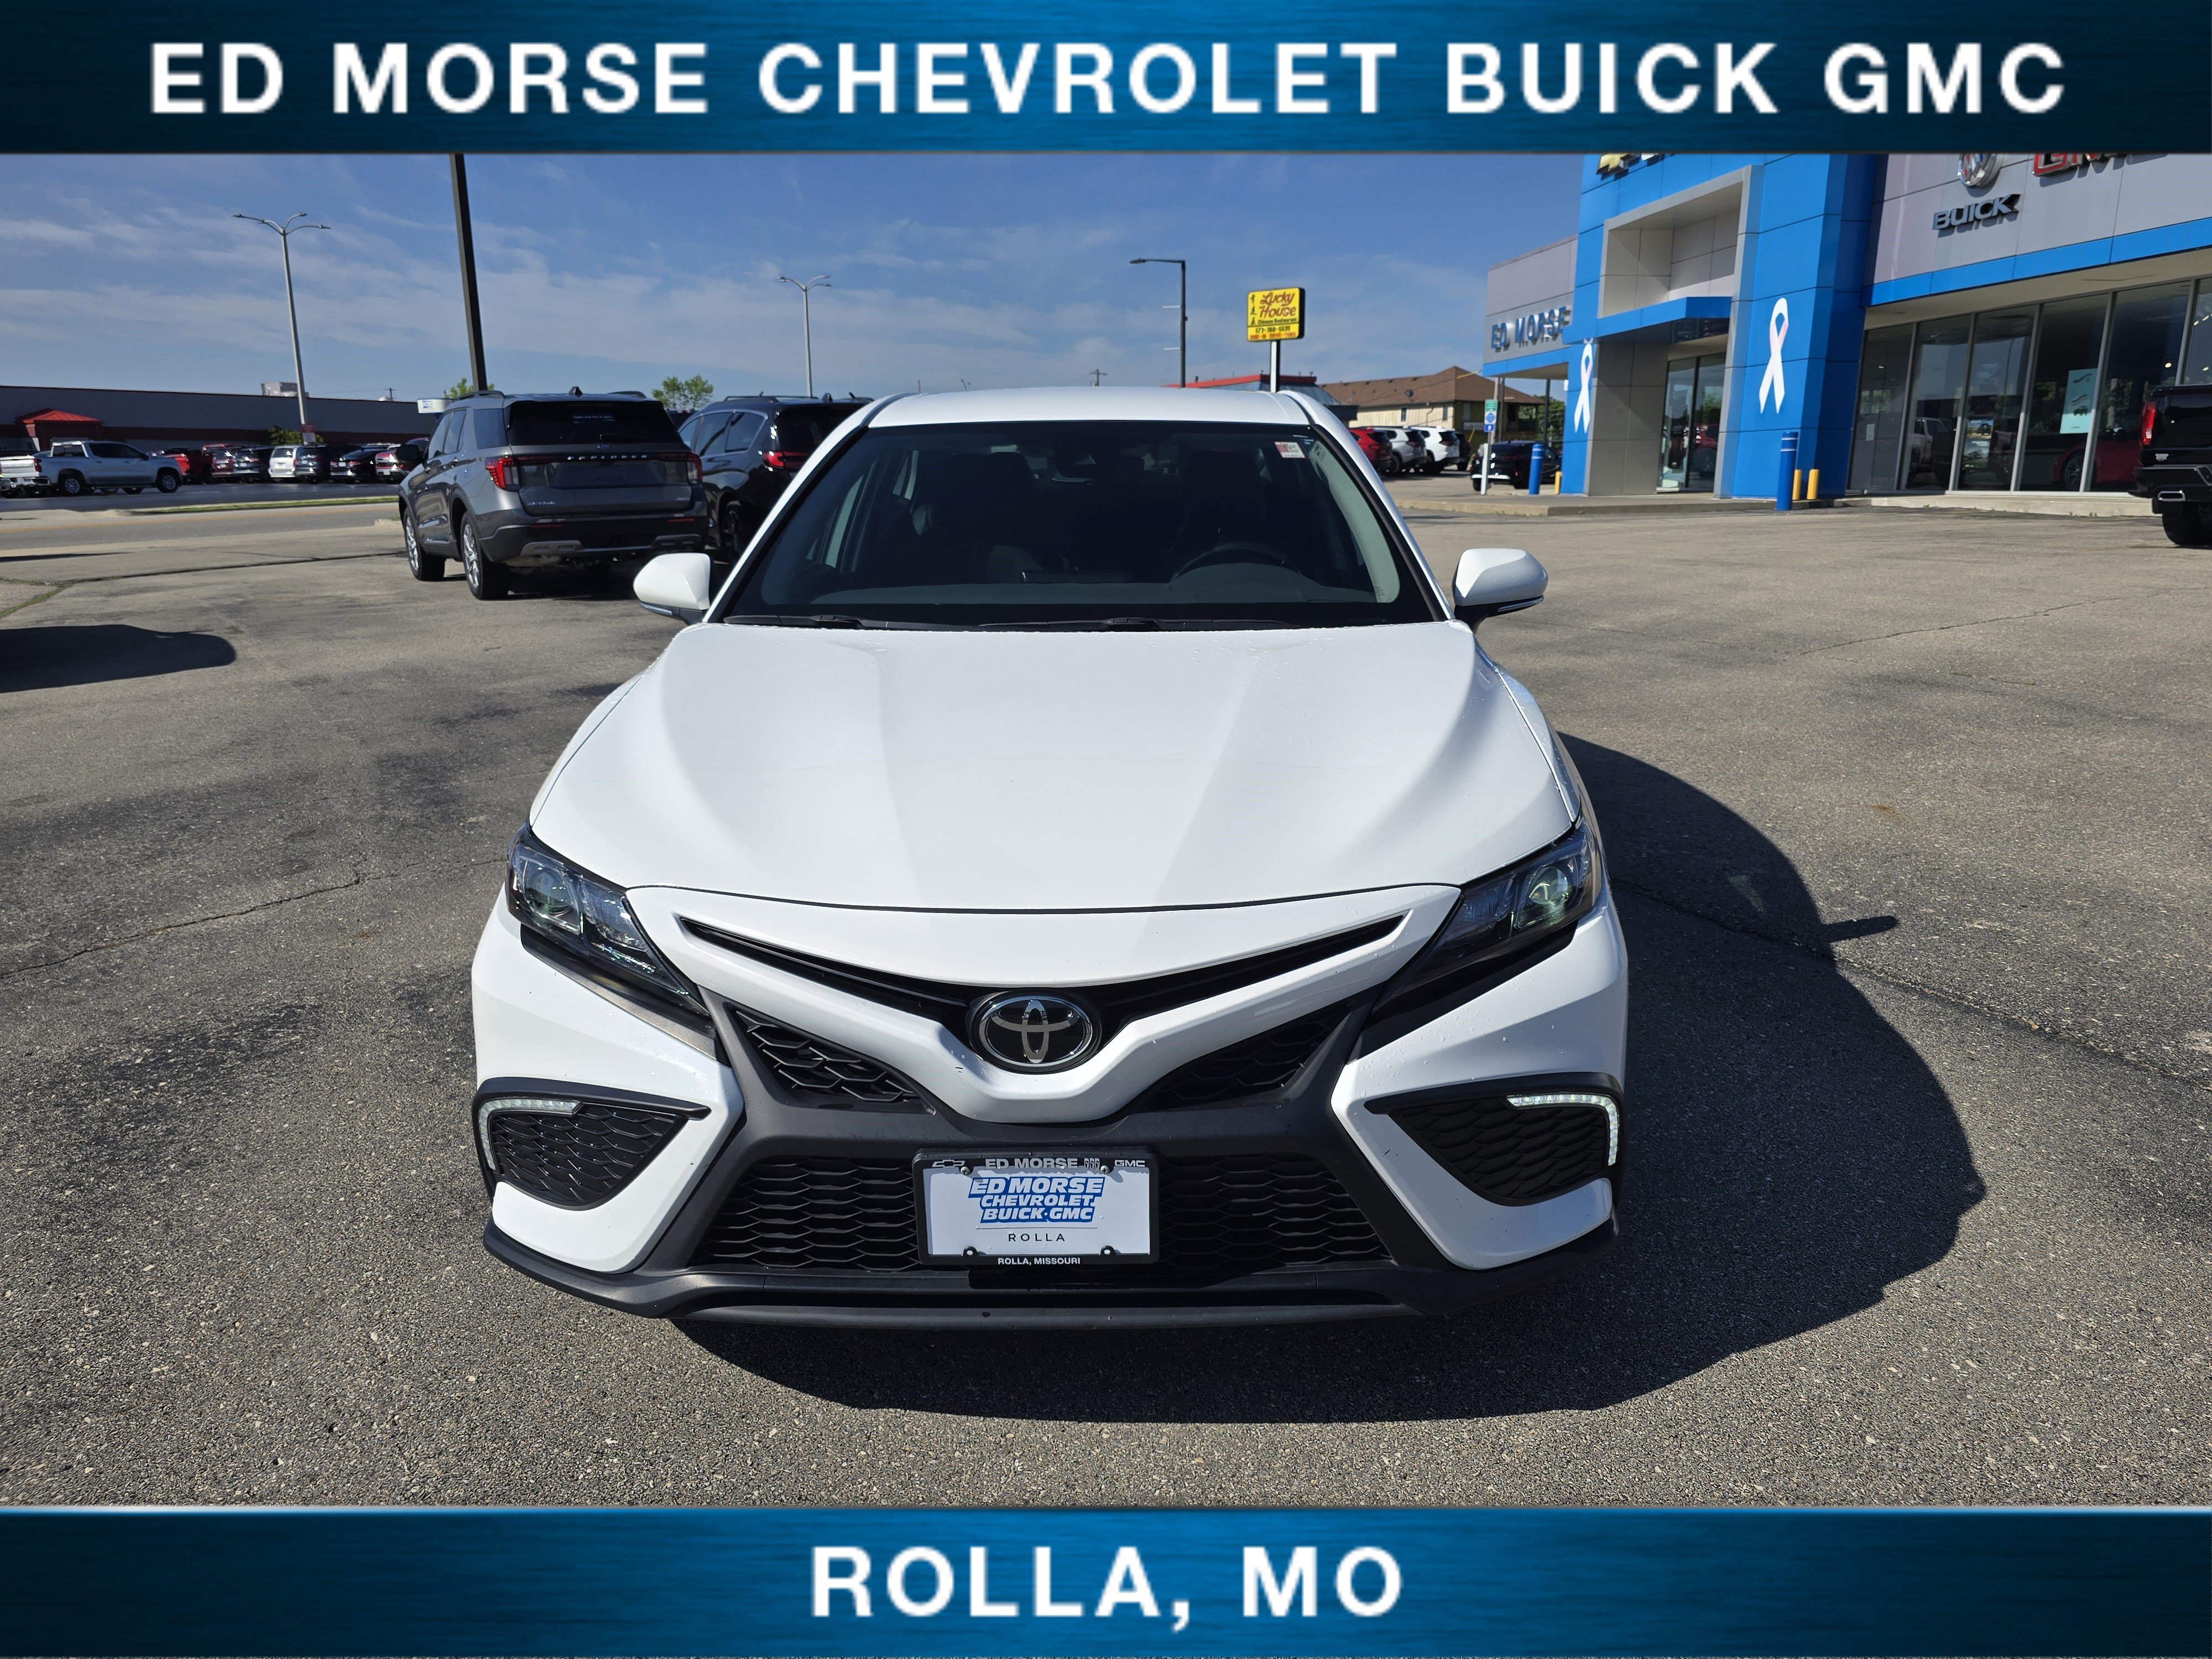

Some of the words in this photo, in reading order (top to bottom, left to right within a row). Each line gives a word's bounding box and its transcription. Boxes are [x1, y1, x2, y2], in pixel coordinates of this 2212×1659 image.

[1933, 194, 2020, 230] BUICK
[1260, 292, 1295, 306] Lucky
[1259, 306, 1296, 319] House
[1491, 322, 1507, 349] ED
[1515, 306, 1567, 343] MORSE
[985, 1159, 1009, 1169] ED
[1014, 1158, 1078, 1169] MORSE
[970, 1178, 1006, 1194] ED
[1008, 1178, 1104, 1193] MORSE
[981, 1194, 1093, 1207] CHEVROLET
[1008, 1233, 1065, 1242] ROLLA
